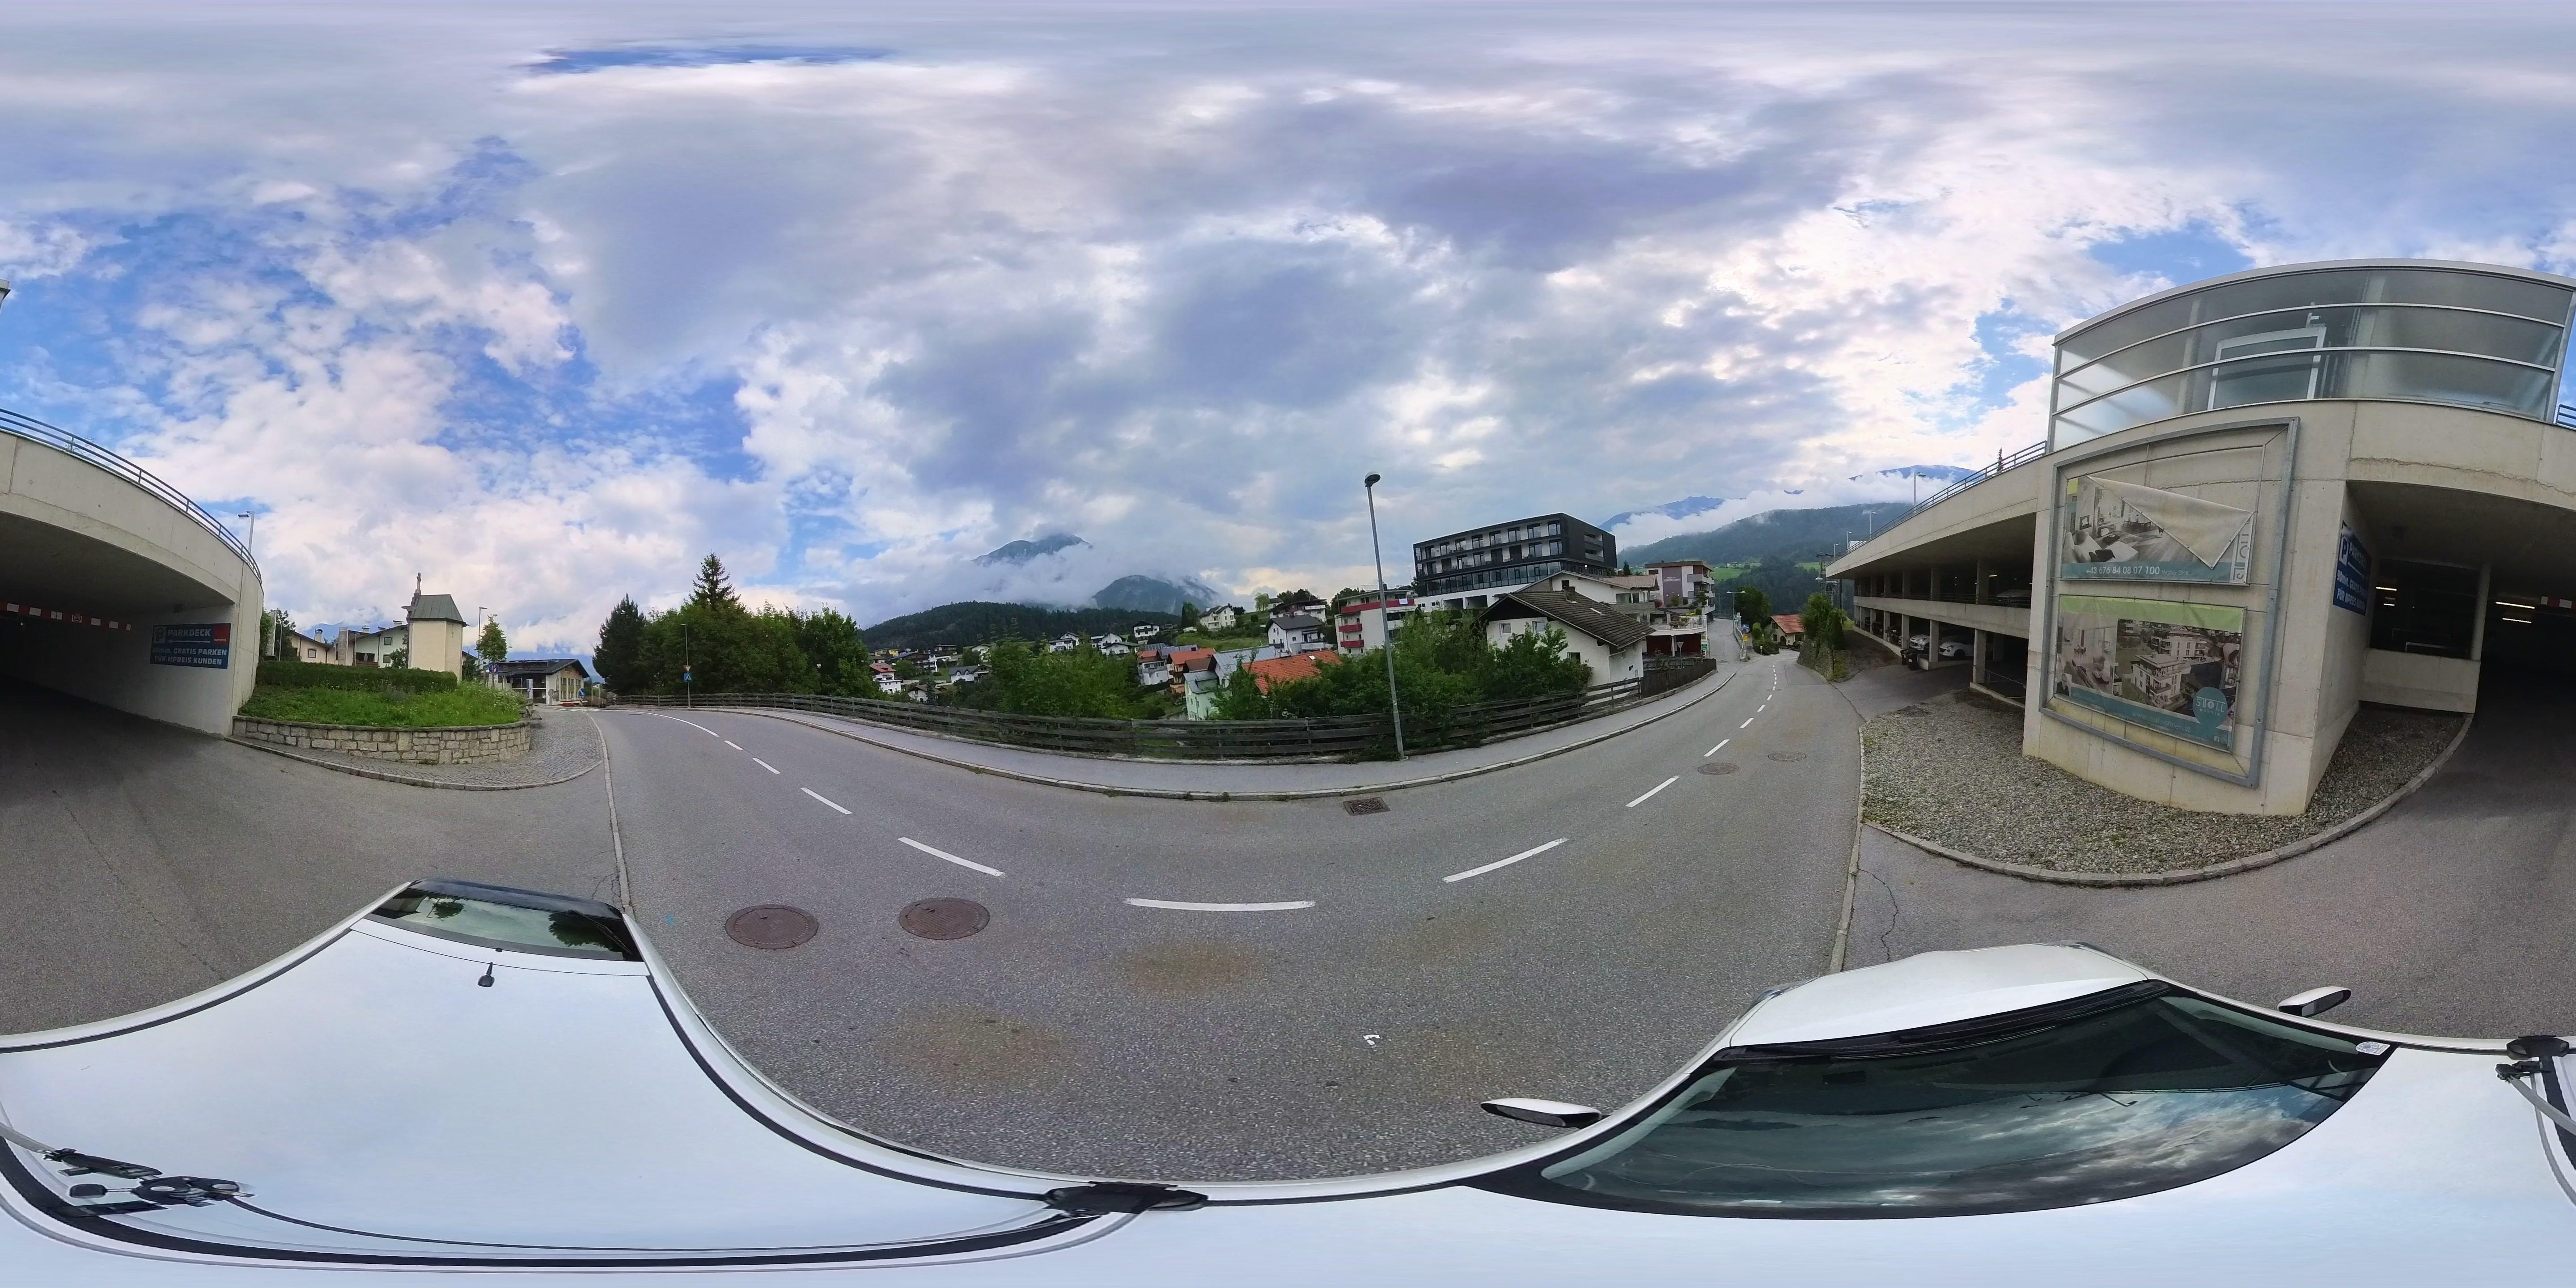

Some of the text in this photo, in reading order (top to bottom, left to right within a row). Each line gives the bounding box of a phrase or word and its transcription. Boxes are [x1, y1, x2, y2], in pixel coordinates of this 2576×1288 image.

[2123, 566, 2131, 574] 08
[2133, 566, 2143, 574] 07
[2145, 566, 2160, 575] 100
[168, 628, 212, 637] PARKDECK
